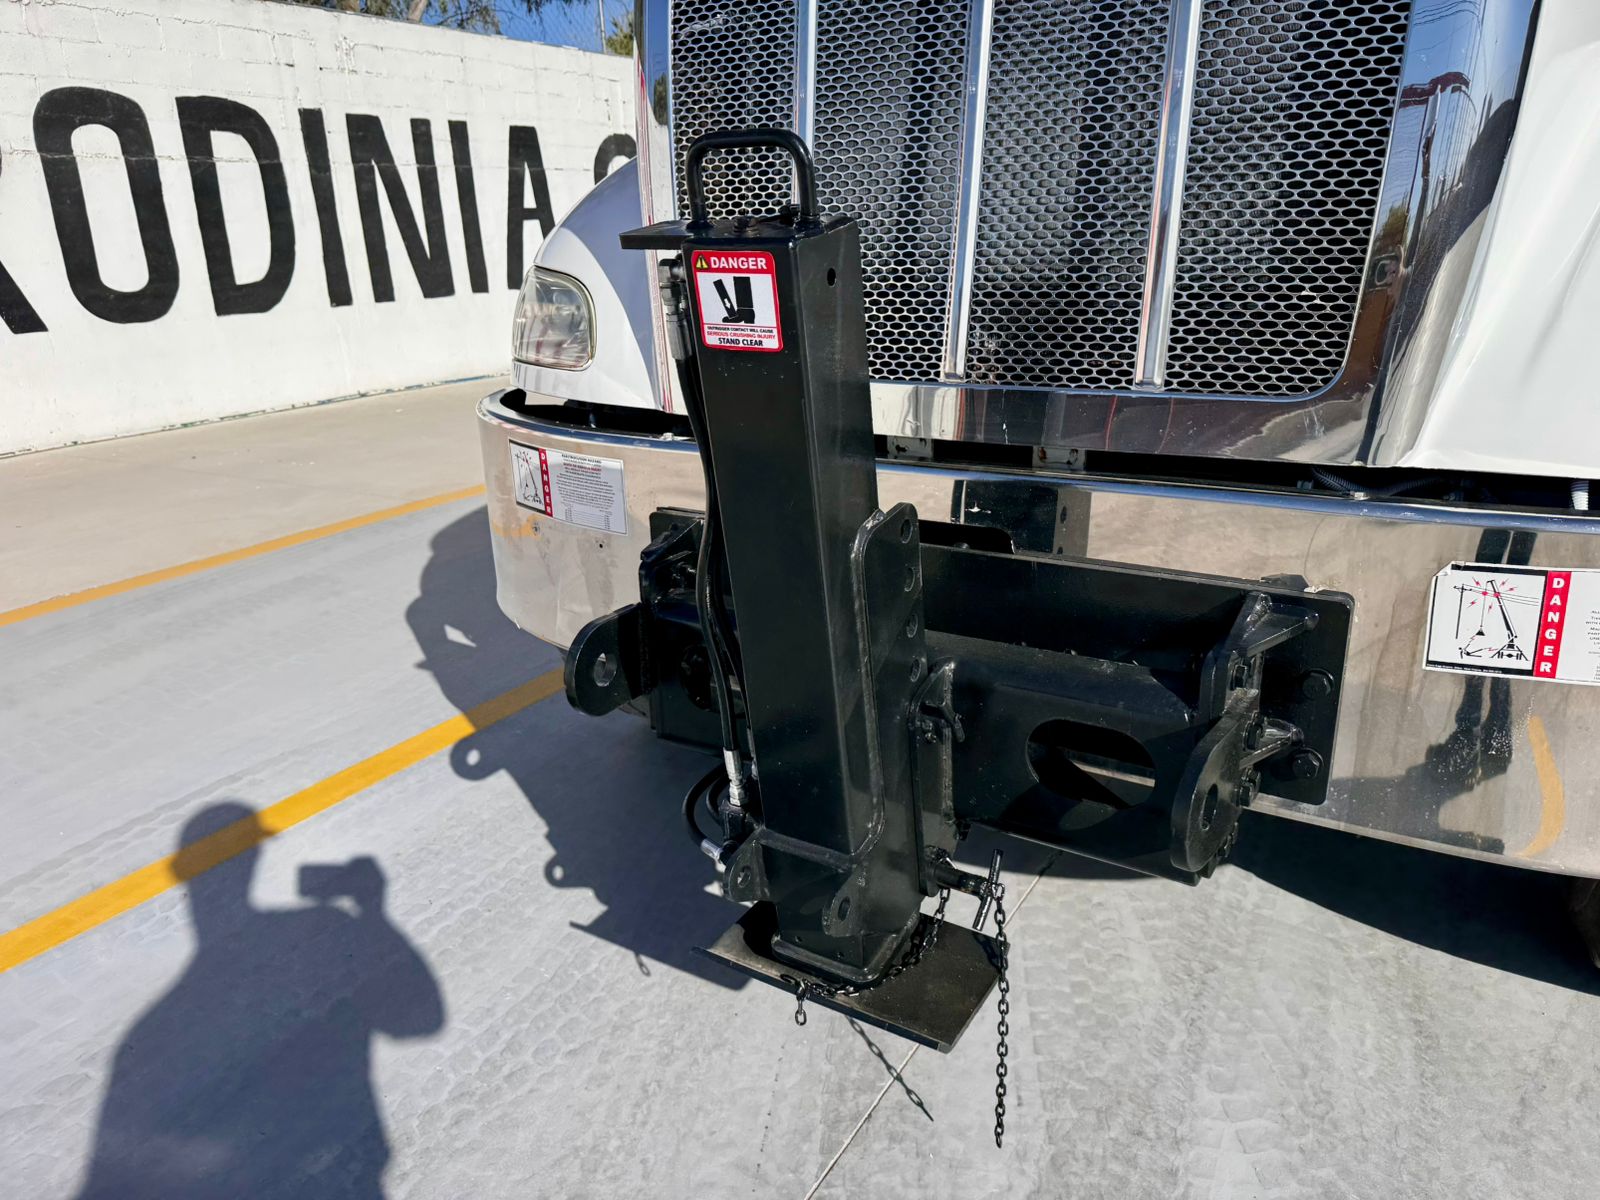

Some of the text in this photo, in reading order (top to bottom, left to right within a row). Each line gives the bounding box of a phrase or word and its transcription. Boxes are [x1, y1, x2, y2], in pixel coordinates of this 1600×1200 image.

[710, 256, 767, 270] DANGER
[718, 337, 763, 347] STAND CLEAR
[540, 452, 551, 514] DANGER
[1540, 577, 1565, 673] DANGER
